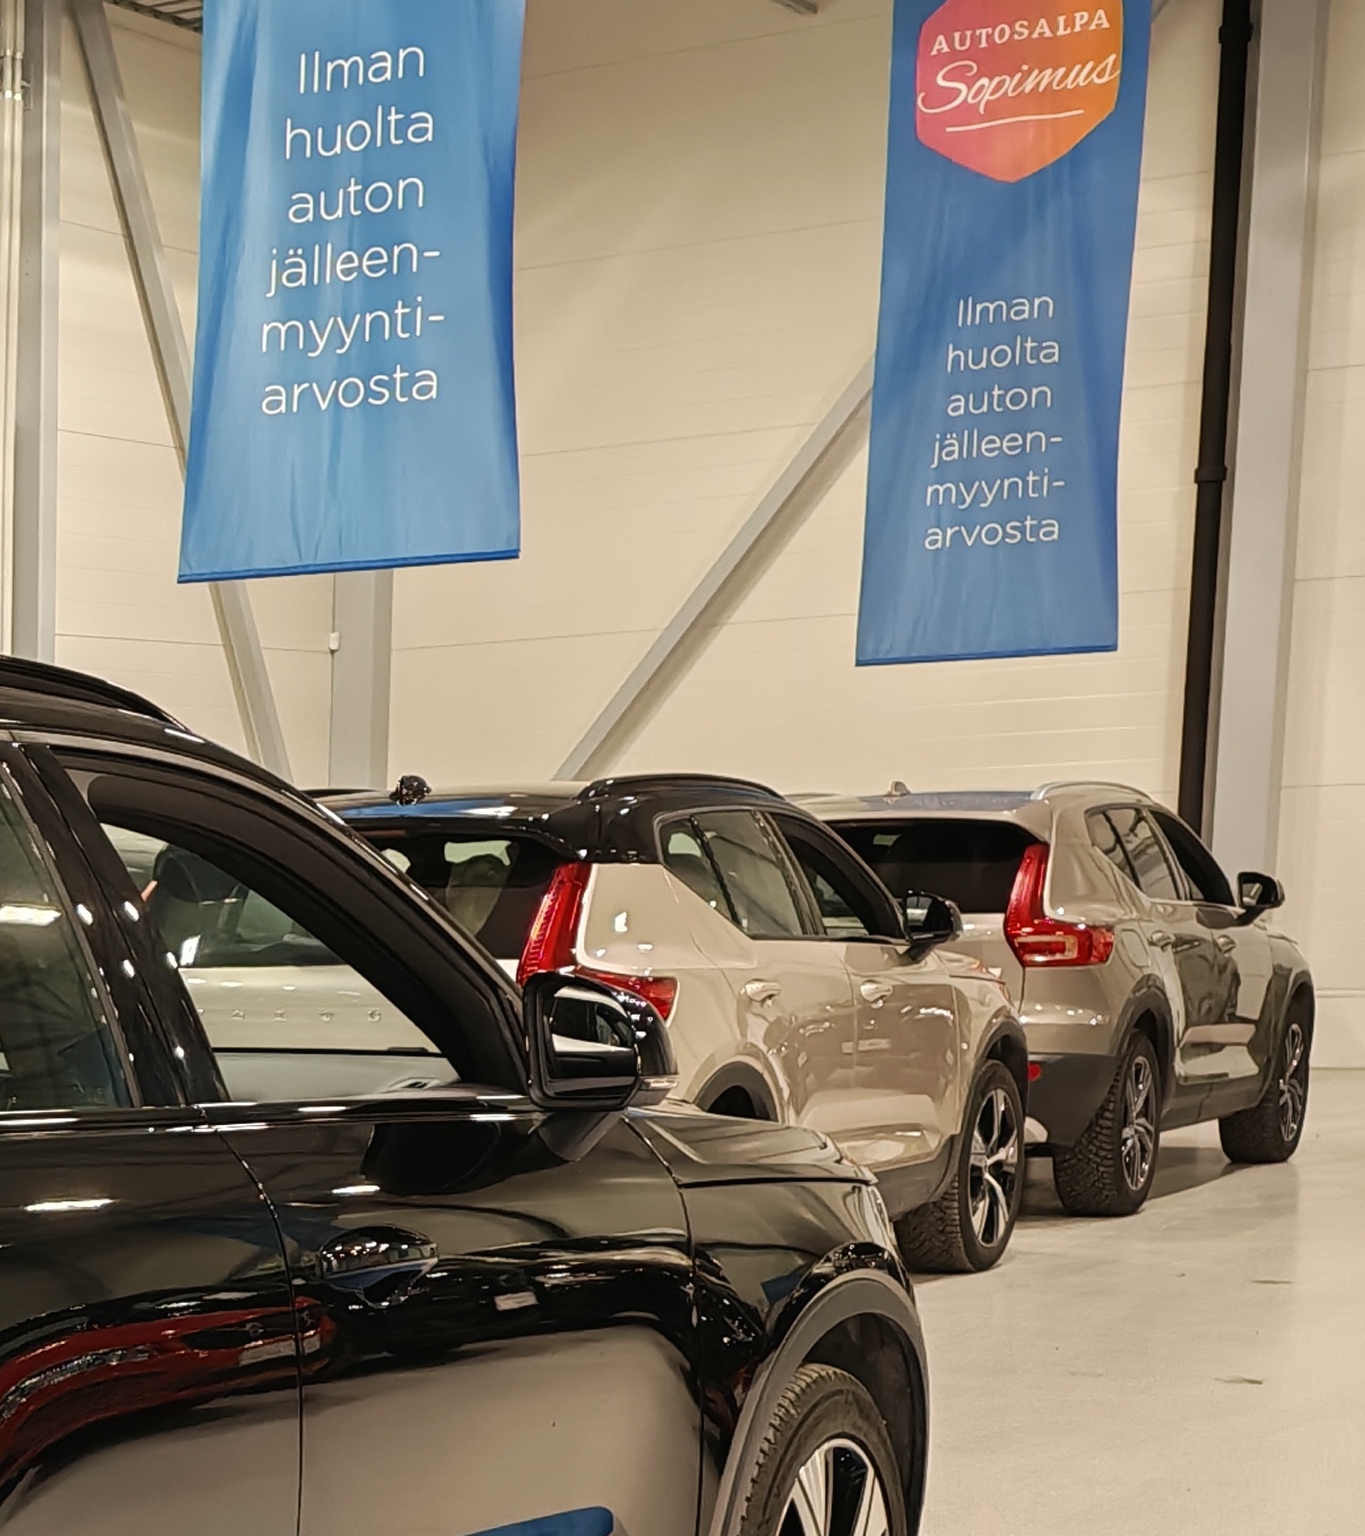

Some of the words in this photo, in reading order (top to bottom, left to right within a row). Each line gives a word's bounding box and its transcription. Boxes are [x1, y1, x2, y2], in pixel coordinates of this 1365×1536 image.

[930, 9, 1111, 56] AUTOSALPA
[299, 45, 426, 95] Ilman
[917, 53, 1120, 115] Sopimus
[285, 105, 434, 160] huolta
[288, 176, 425, 224] auton
[265, 240, 441, 298] jälleen-
[261, 296, 445, 357] myynti-
[956, 293, 1055, 329] Ilman
[946, 334, 1060, 375] huolta
[260, 363, 439, 415] arvosta
[946, 381, 1053, 419] auton
[930, 428, 1064, 469] jälleen-
[925, 470, 1065, 510] myynti-
[923, 517, 1060, 552] arvosta
